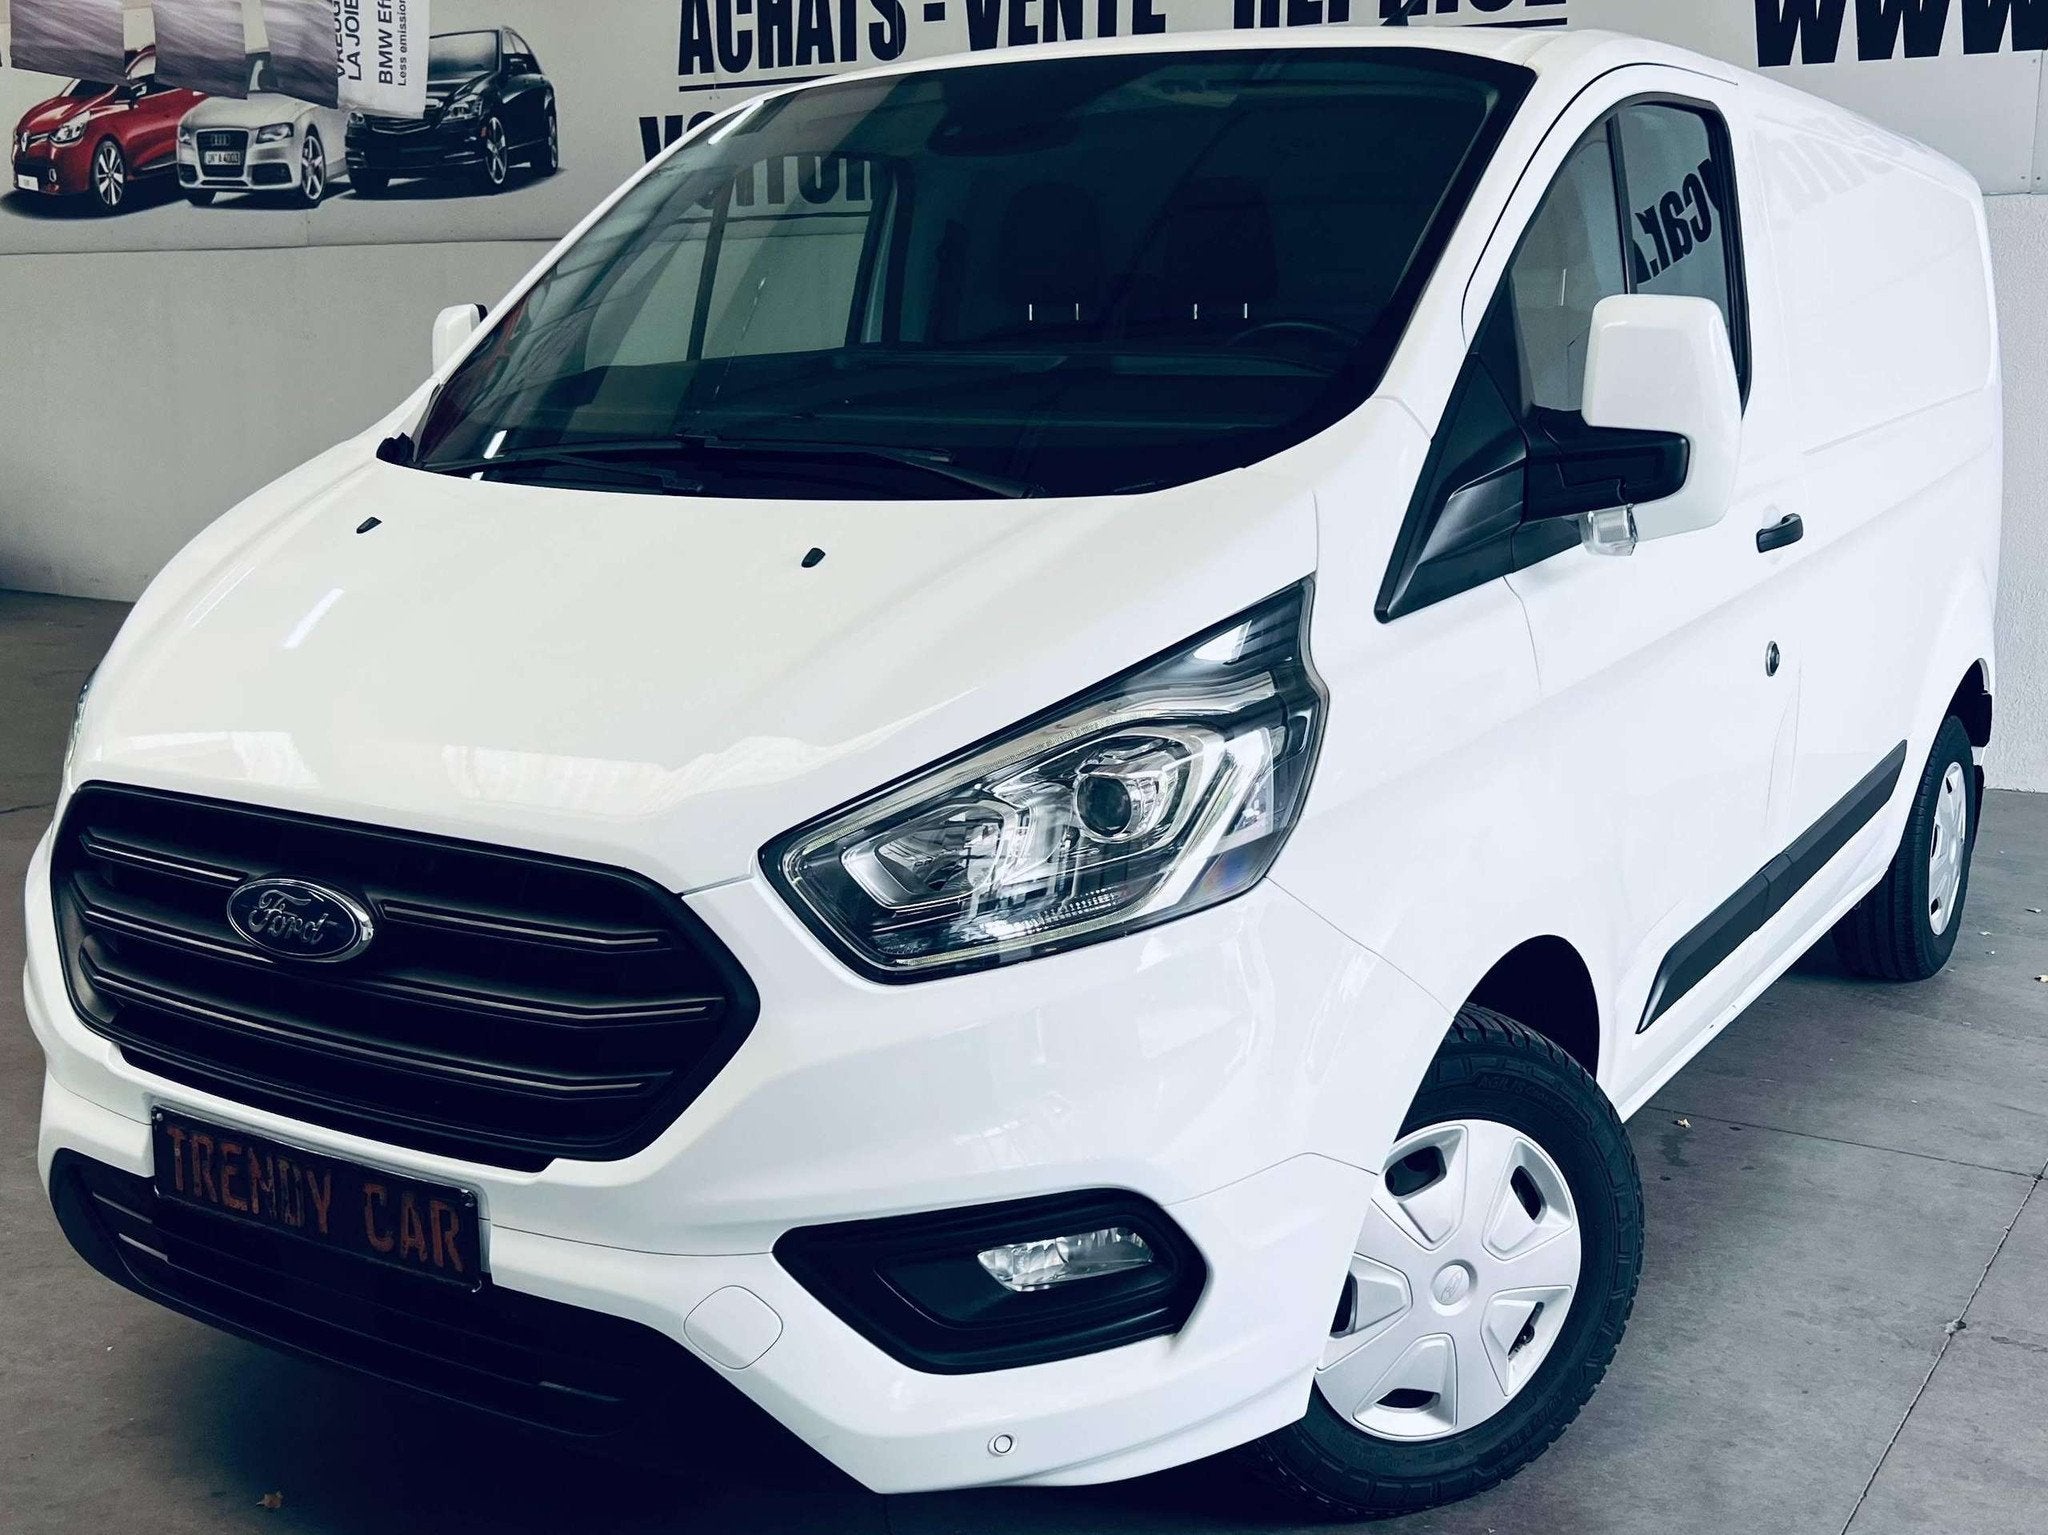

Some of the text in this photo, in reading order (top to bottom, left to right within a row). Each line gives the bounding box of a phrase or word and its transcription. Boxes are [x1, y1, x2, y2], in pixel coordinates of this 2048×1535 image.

[344, 0, 361, 81] LA JOIE
[377, 0, 393, 85] BMW Ef
[397, 57, 407, 86] Less
[249, 889, 327, 945] Ford
[362, 1182, 464, 1273] CAR
